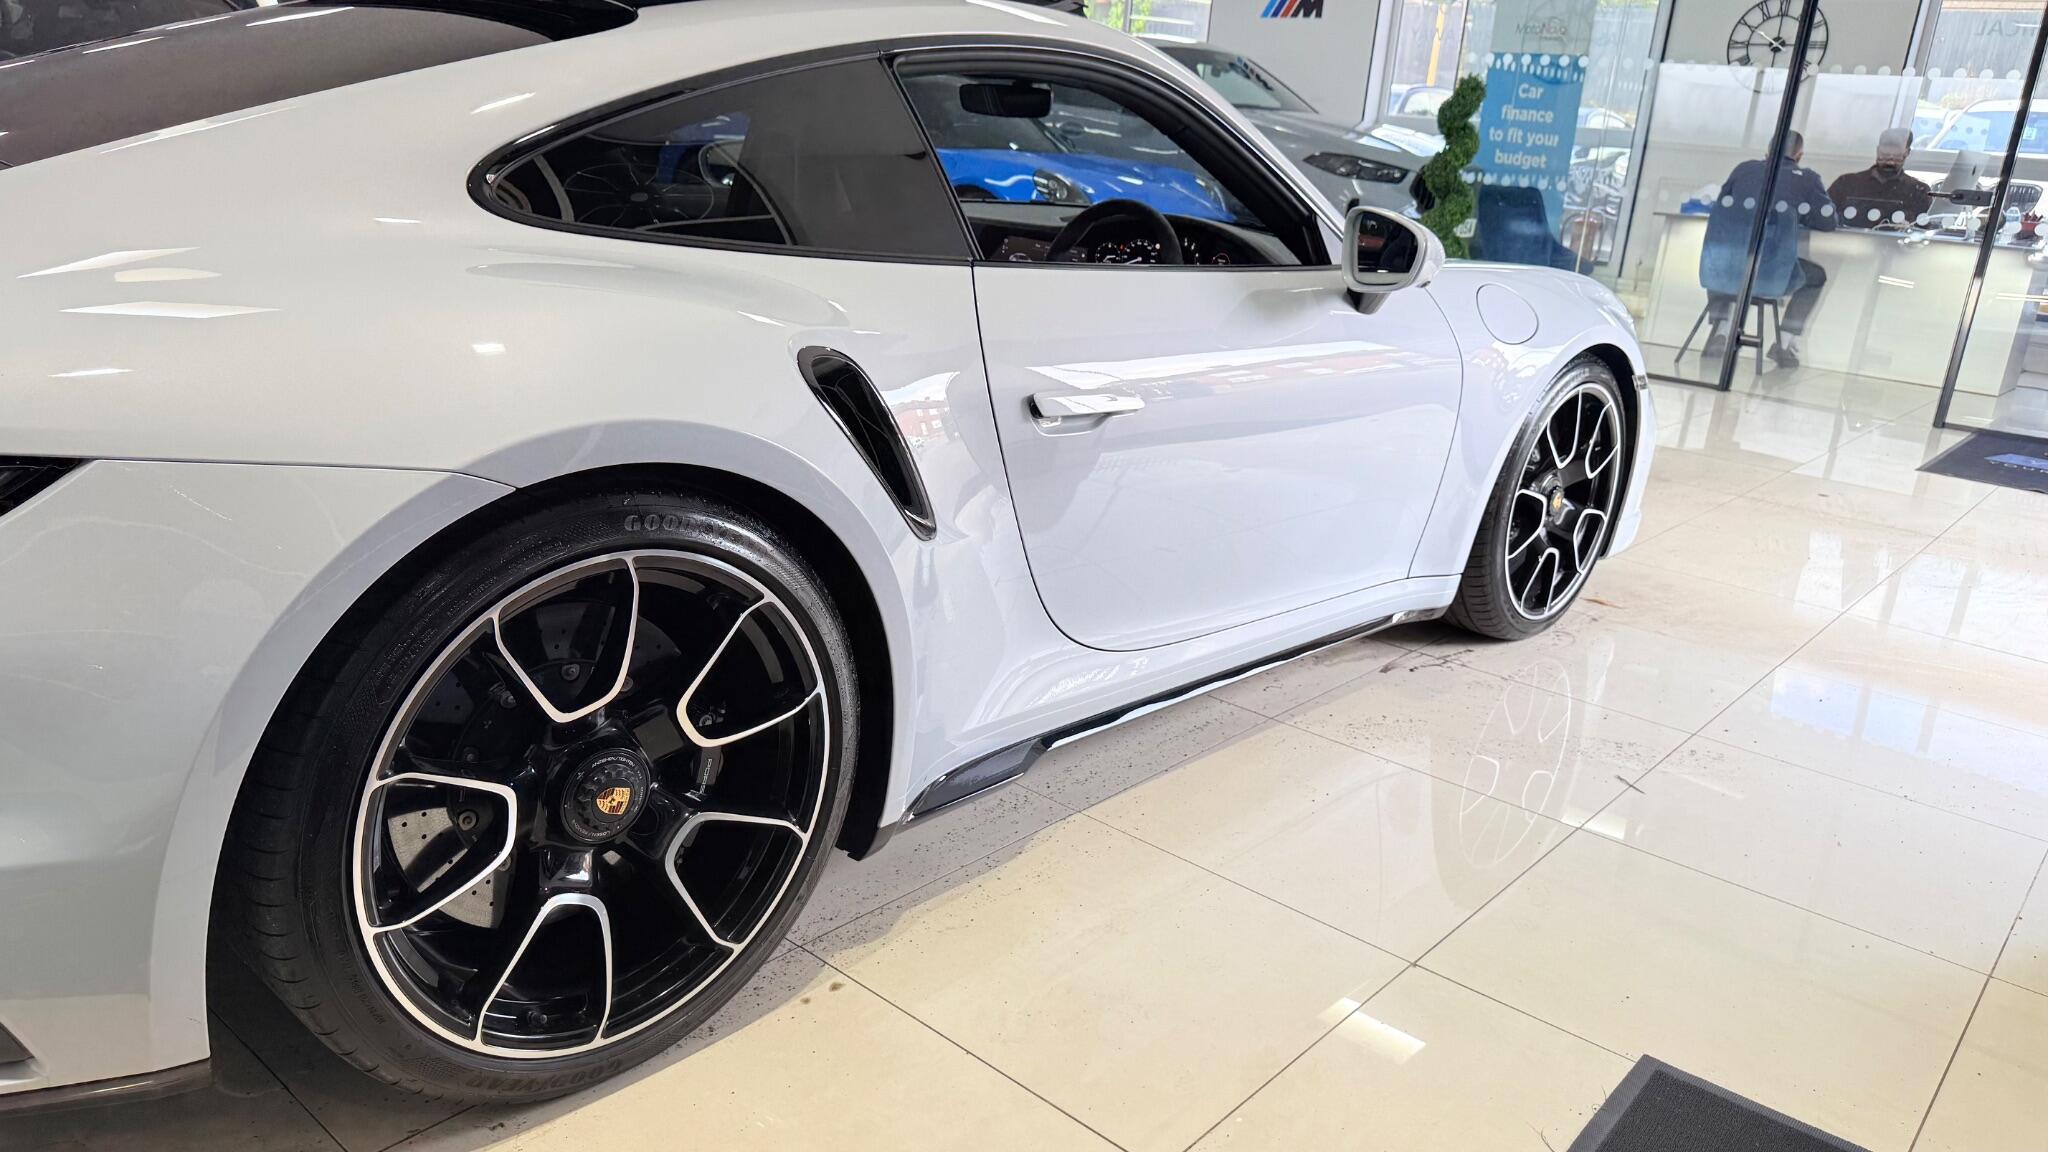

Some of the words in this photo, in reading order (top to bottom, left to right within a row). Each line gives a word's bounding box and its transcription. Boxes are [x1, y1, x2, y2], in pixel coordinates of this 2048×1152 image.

[1518, 83, 1544, 99] Car
[1501, 104, 1554, 123] finance
[1489, 126, 1504, 141] to
[1507, 127, 1524, 143] fit
[1526, 132, 1560, 147] your
[1494, 149, 1548, 169] budget
